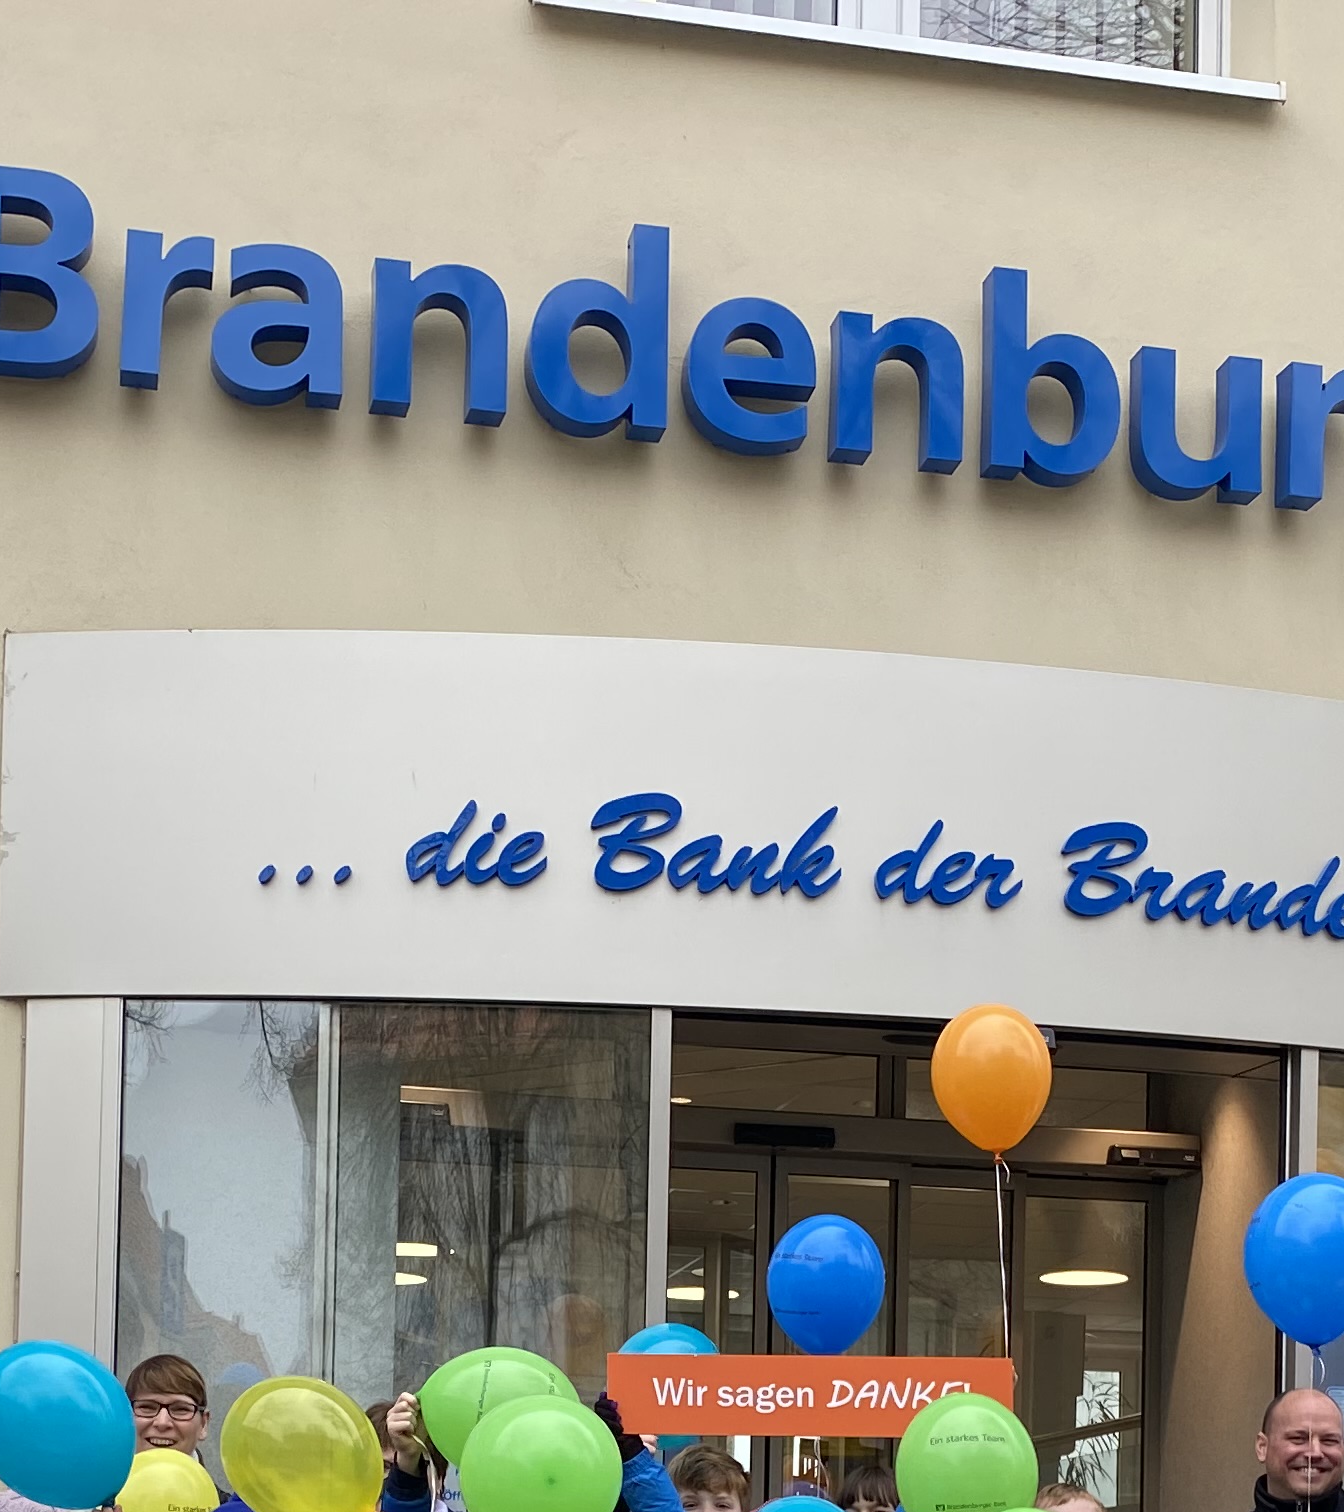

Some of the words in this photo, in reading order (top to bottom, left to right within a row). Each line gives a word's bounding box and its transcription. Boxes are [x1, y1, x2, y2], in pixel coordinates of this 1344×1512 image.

[406, 801, 547, 887] die
[592, 792, 842, 899] Bank
[875, 820, 1023, 910] der
[652, 1376, 705, 1408] Wir
[716, 1382, 814, 1414] sagen
[929, 1437, 944, 1446] Ein
[946, 1433, 979, 1444] starkes
[981, 1432, 1006, 1444] Team
